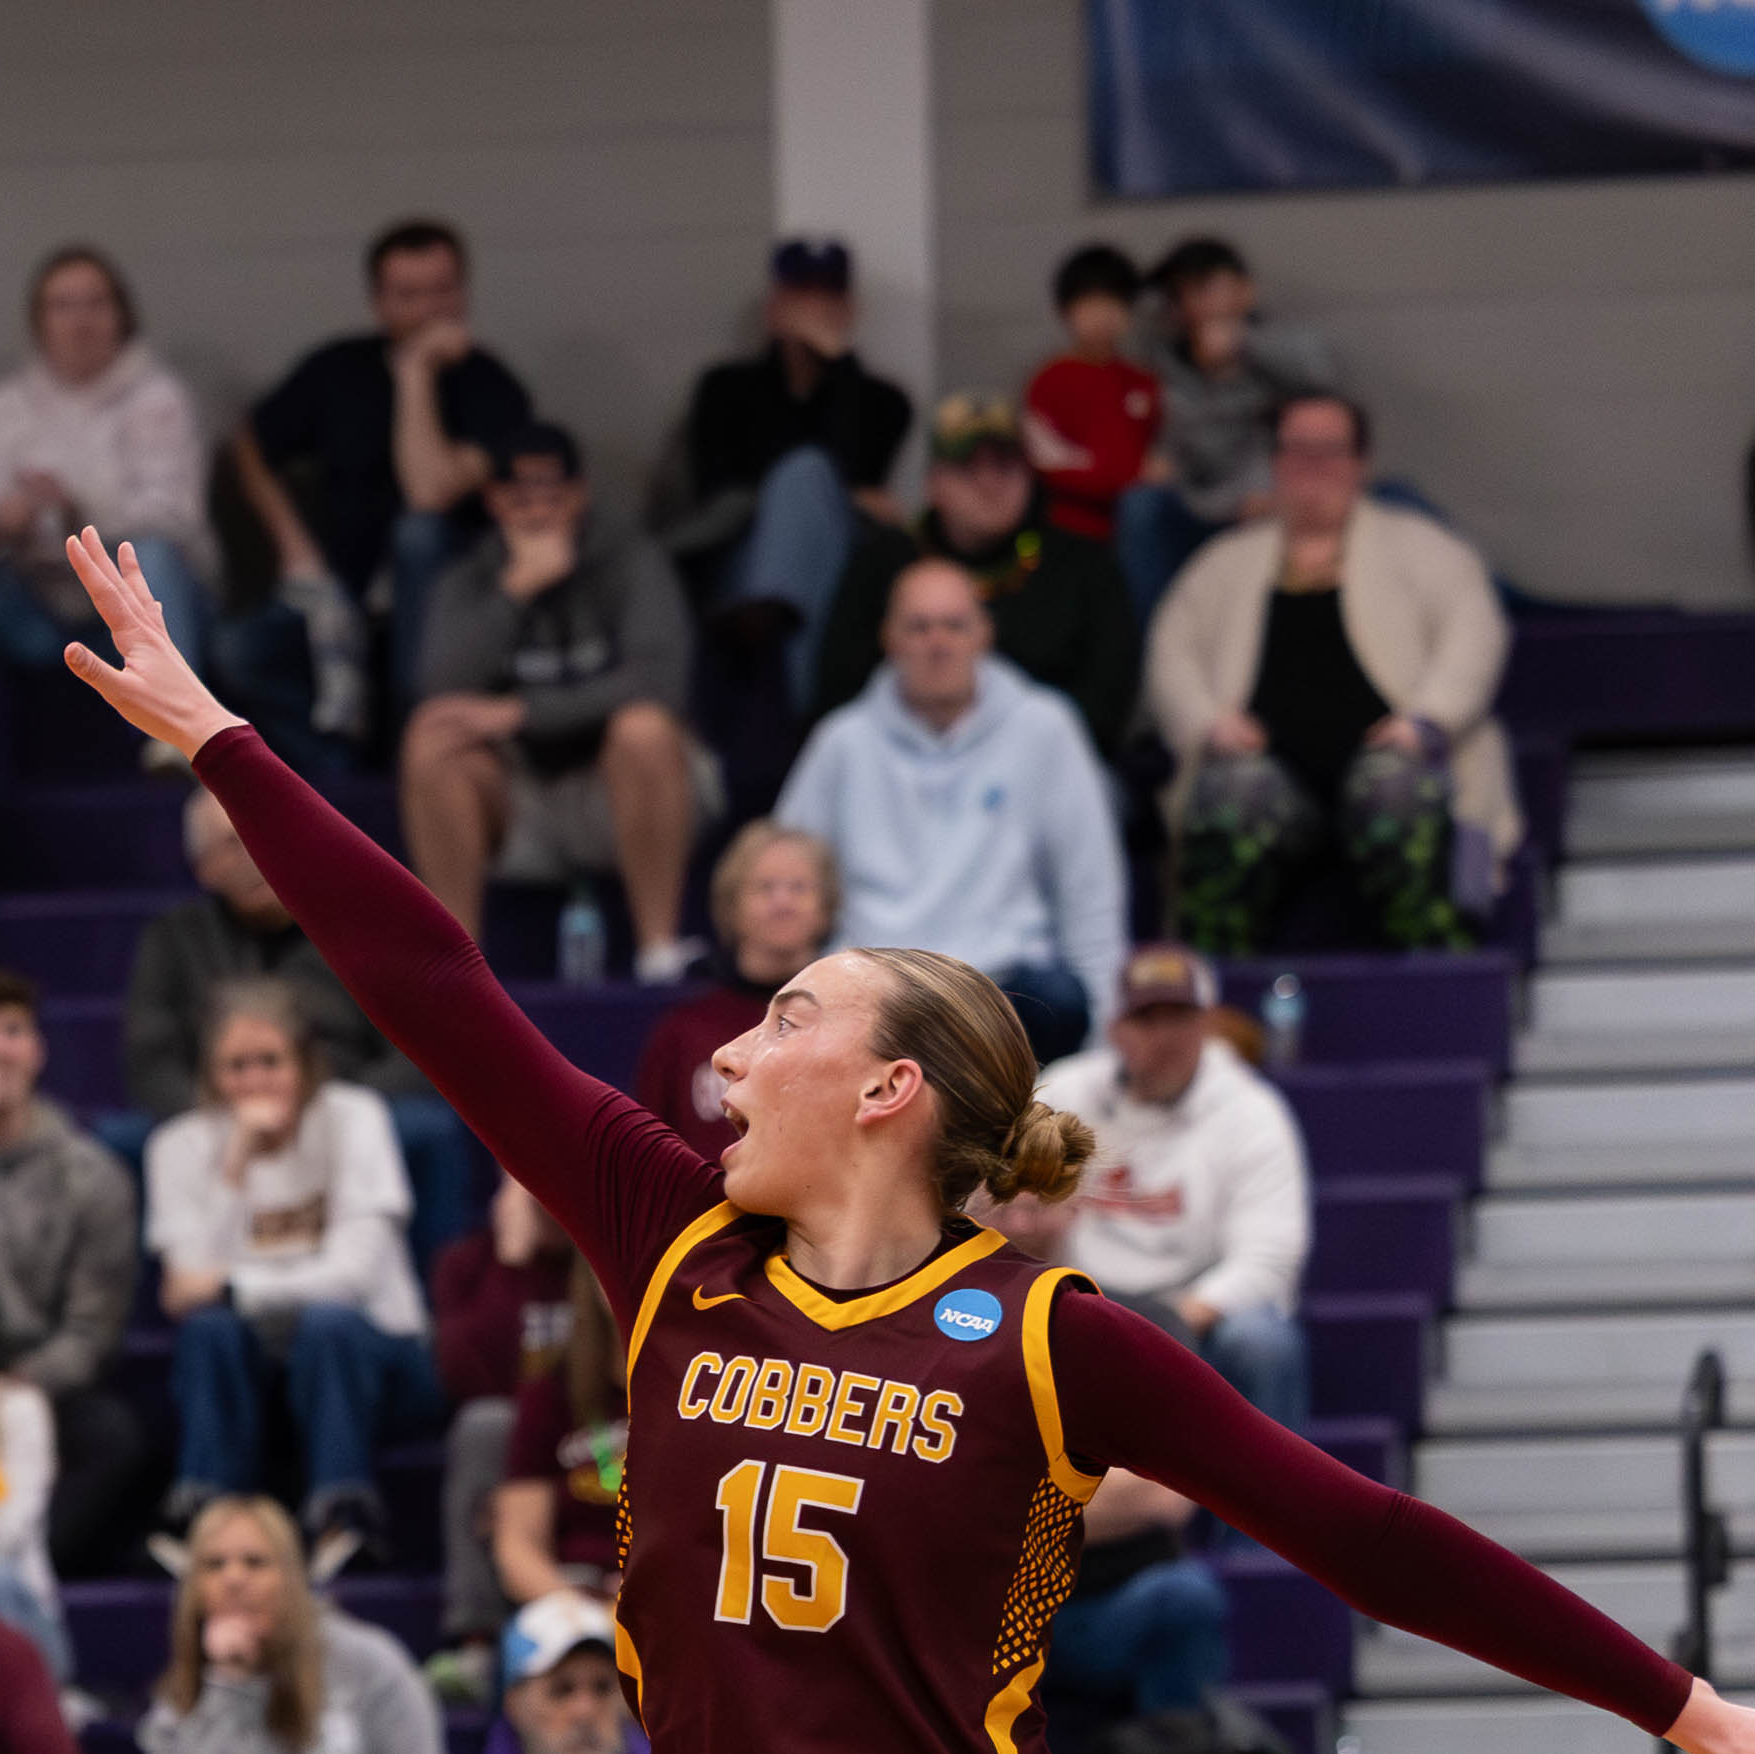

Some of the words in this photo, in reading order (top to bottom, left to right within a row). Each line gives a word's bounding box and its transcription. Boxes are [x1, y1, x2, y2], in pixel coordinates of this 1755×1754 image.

[939, 1307, 995, 1333] NCAA
[678, 1352, 964, 1463] COBBERS
[713, 1459, 865, 1633] 15
